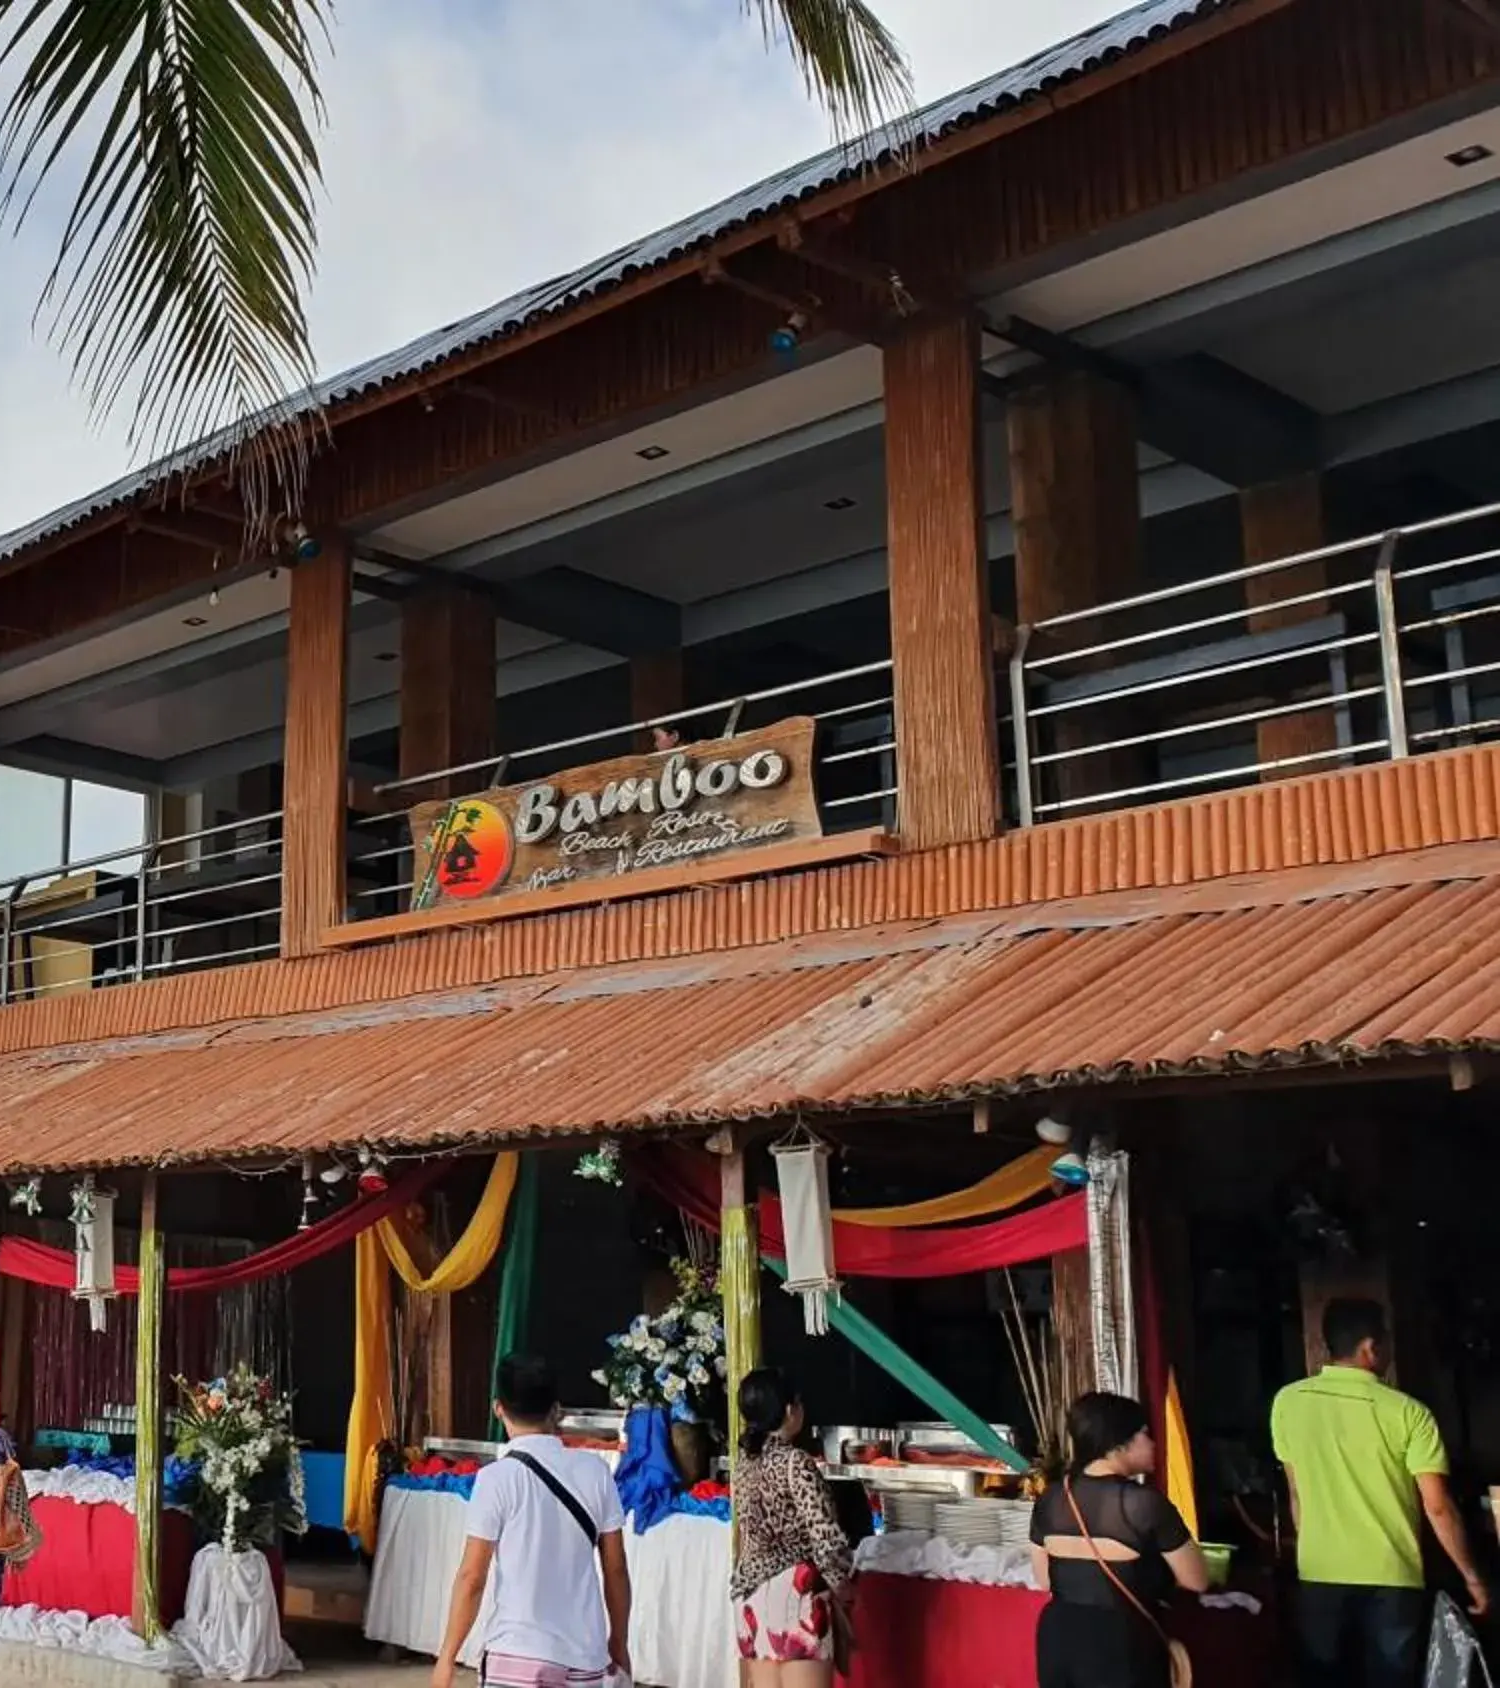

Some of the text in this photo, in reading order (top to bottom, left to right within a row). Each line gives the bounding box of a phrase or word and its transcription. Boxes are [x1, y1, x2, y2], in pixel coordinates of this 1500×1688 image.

[515, 749, 787, 844] Bamboo
[559, 831, 631, 858] Beach
[633, 816, 789, 867] Restaurant
